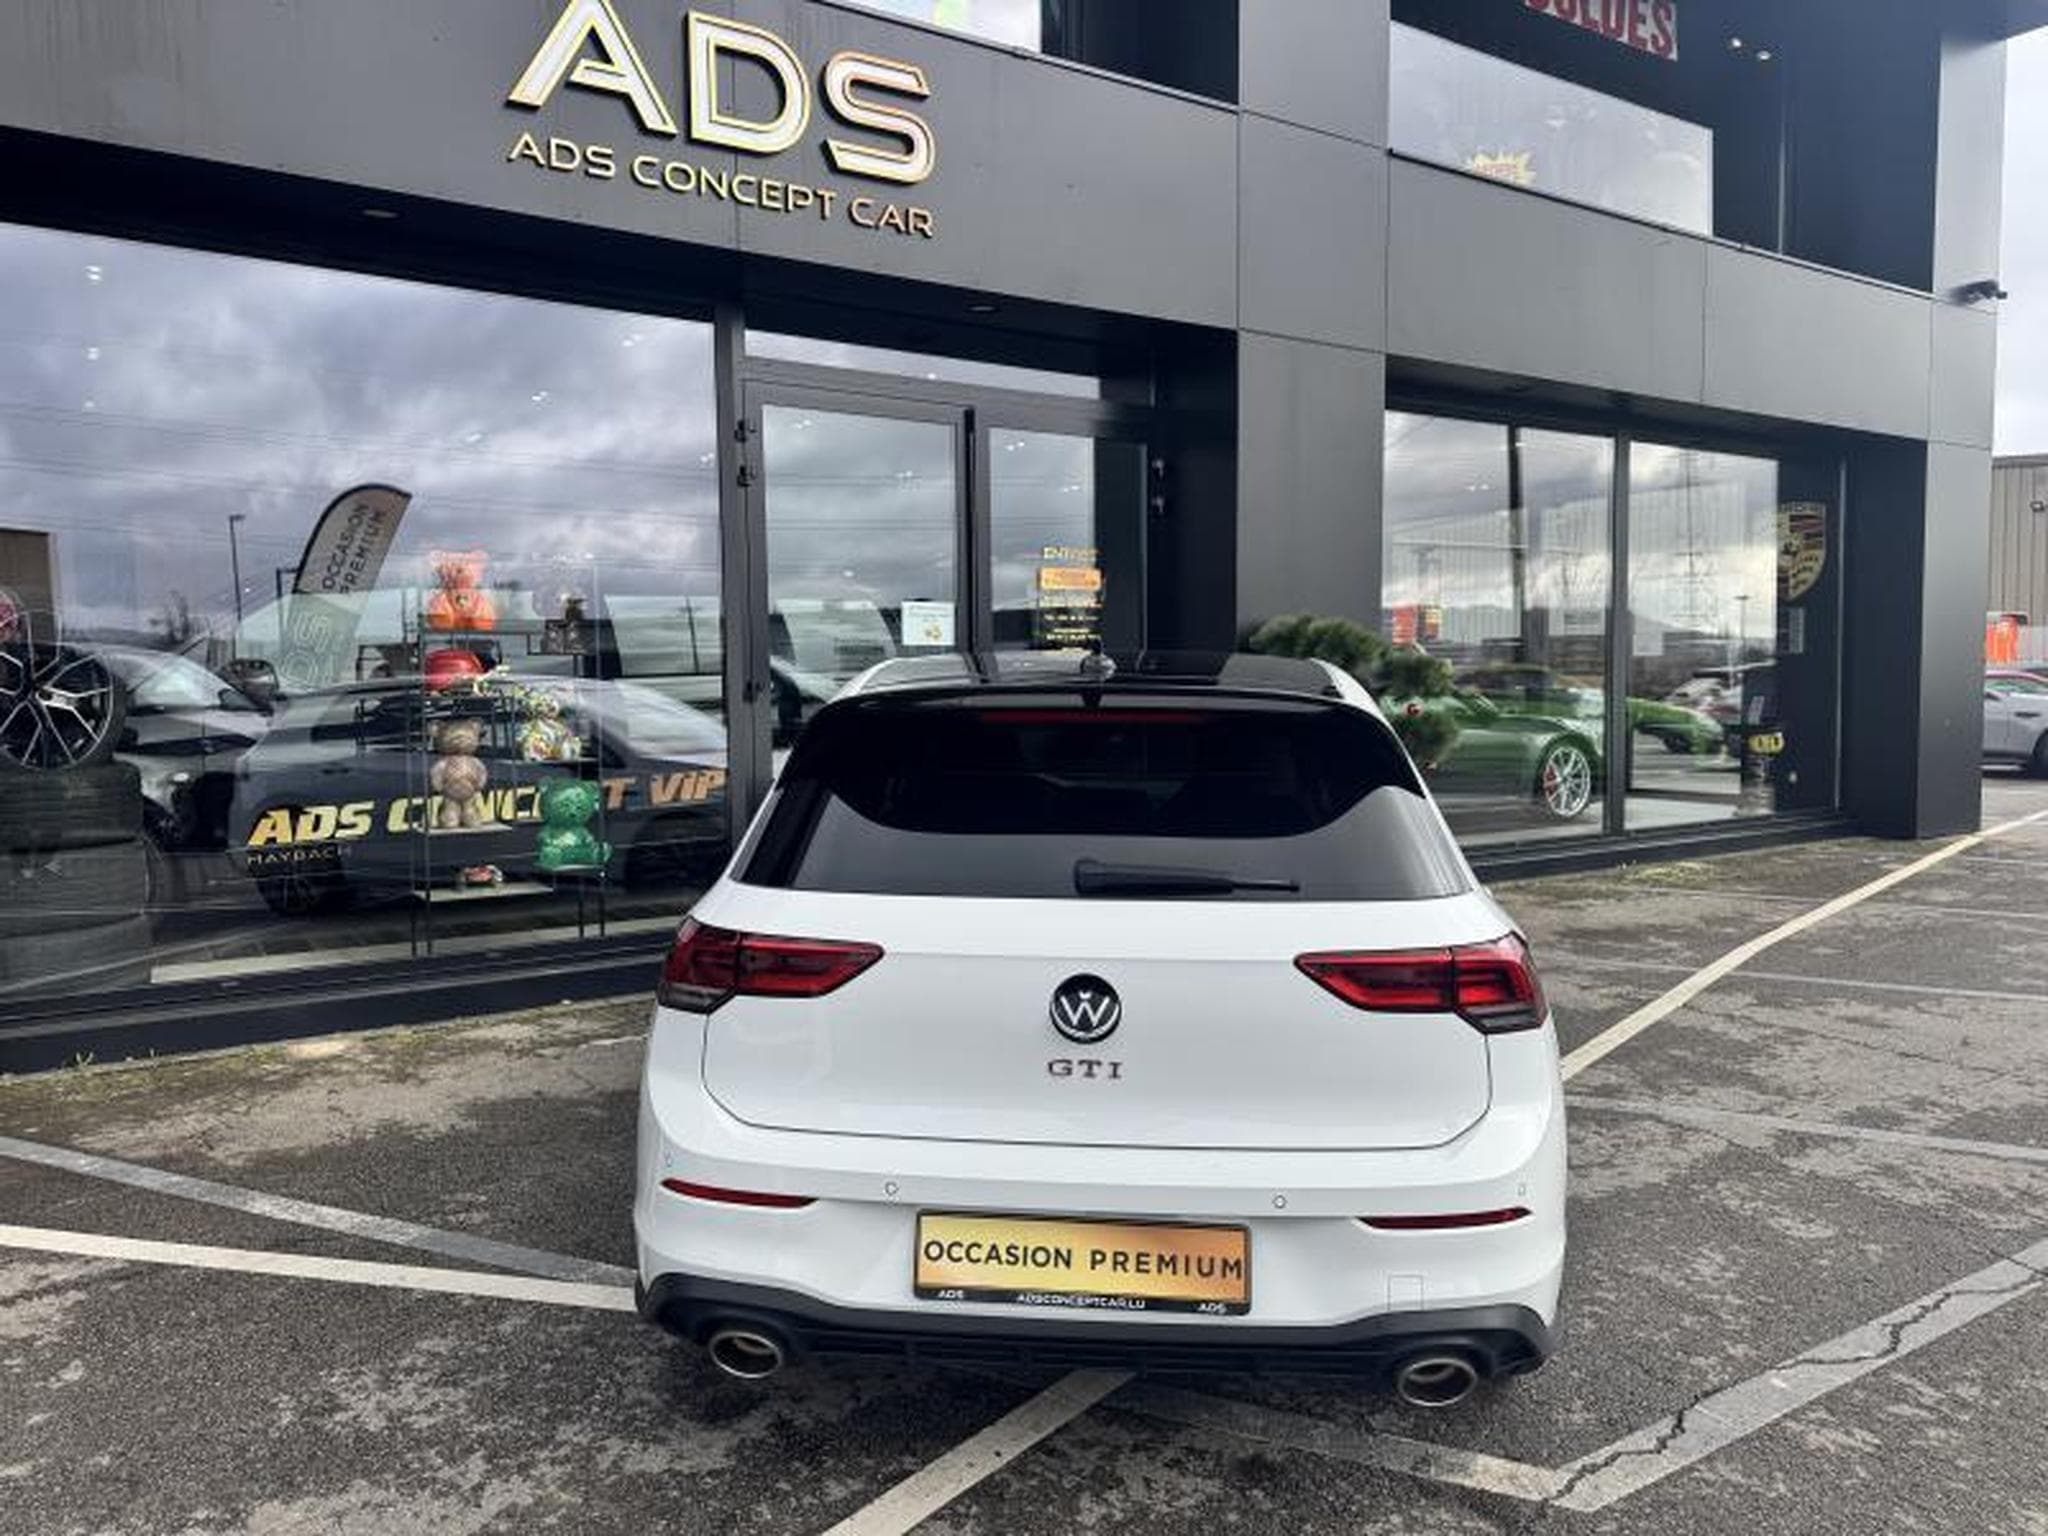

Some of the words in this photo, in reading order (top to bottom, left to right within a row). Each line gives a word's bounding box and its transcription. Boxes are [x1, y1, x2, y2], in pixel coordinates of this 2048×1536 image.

[506, 0, 935, 184] ADS
[508, 132, 615, 177] ADS
[632, 155, 836, 220] CONCEPT
[851, 197, 933, 237] CAR
[322, 502, 370, 591] OCCASION
[247, 801, 374, 847] ADS
[1047, 1058, 1123, 1079] GTI
[924, 1240, 1072, 1269] OCCASION
[1090, 1249, 1242, 1279] PREMIUM
